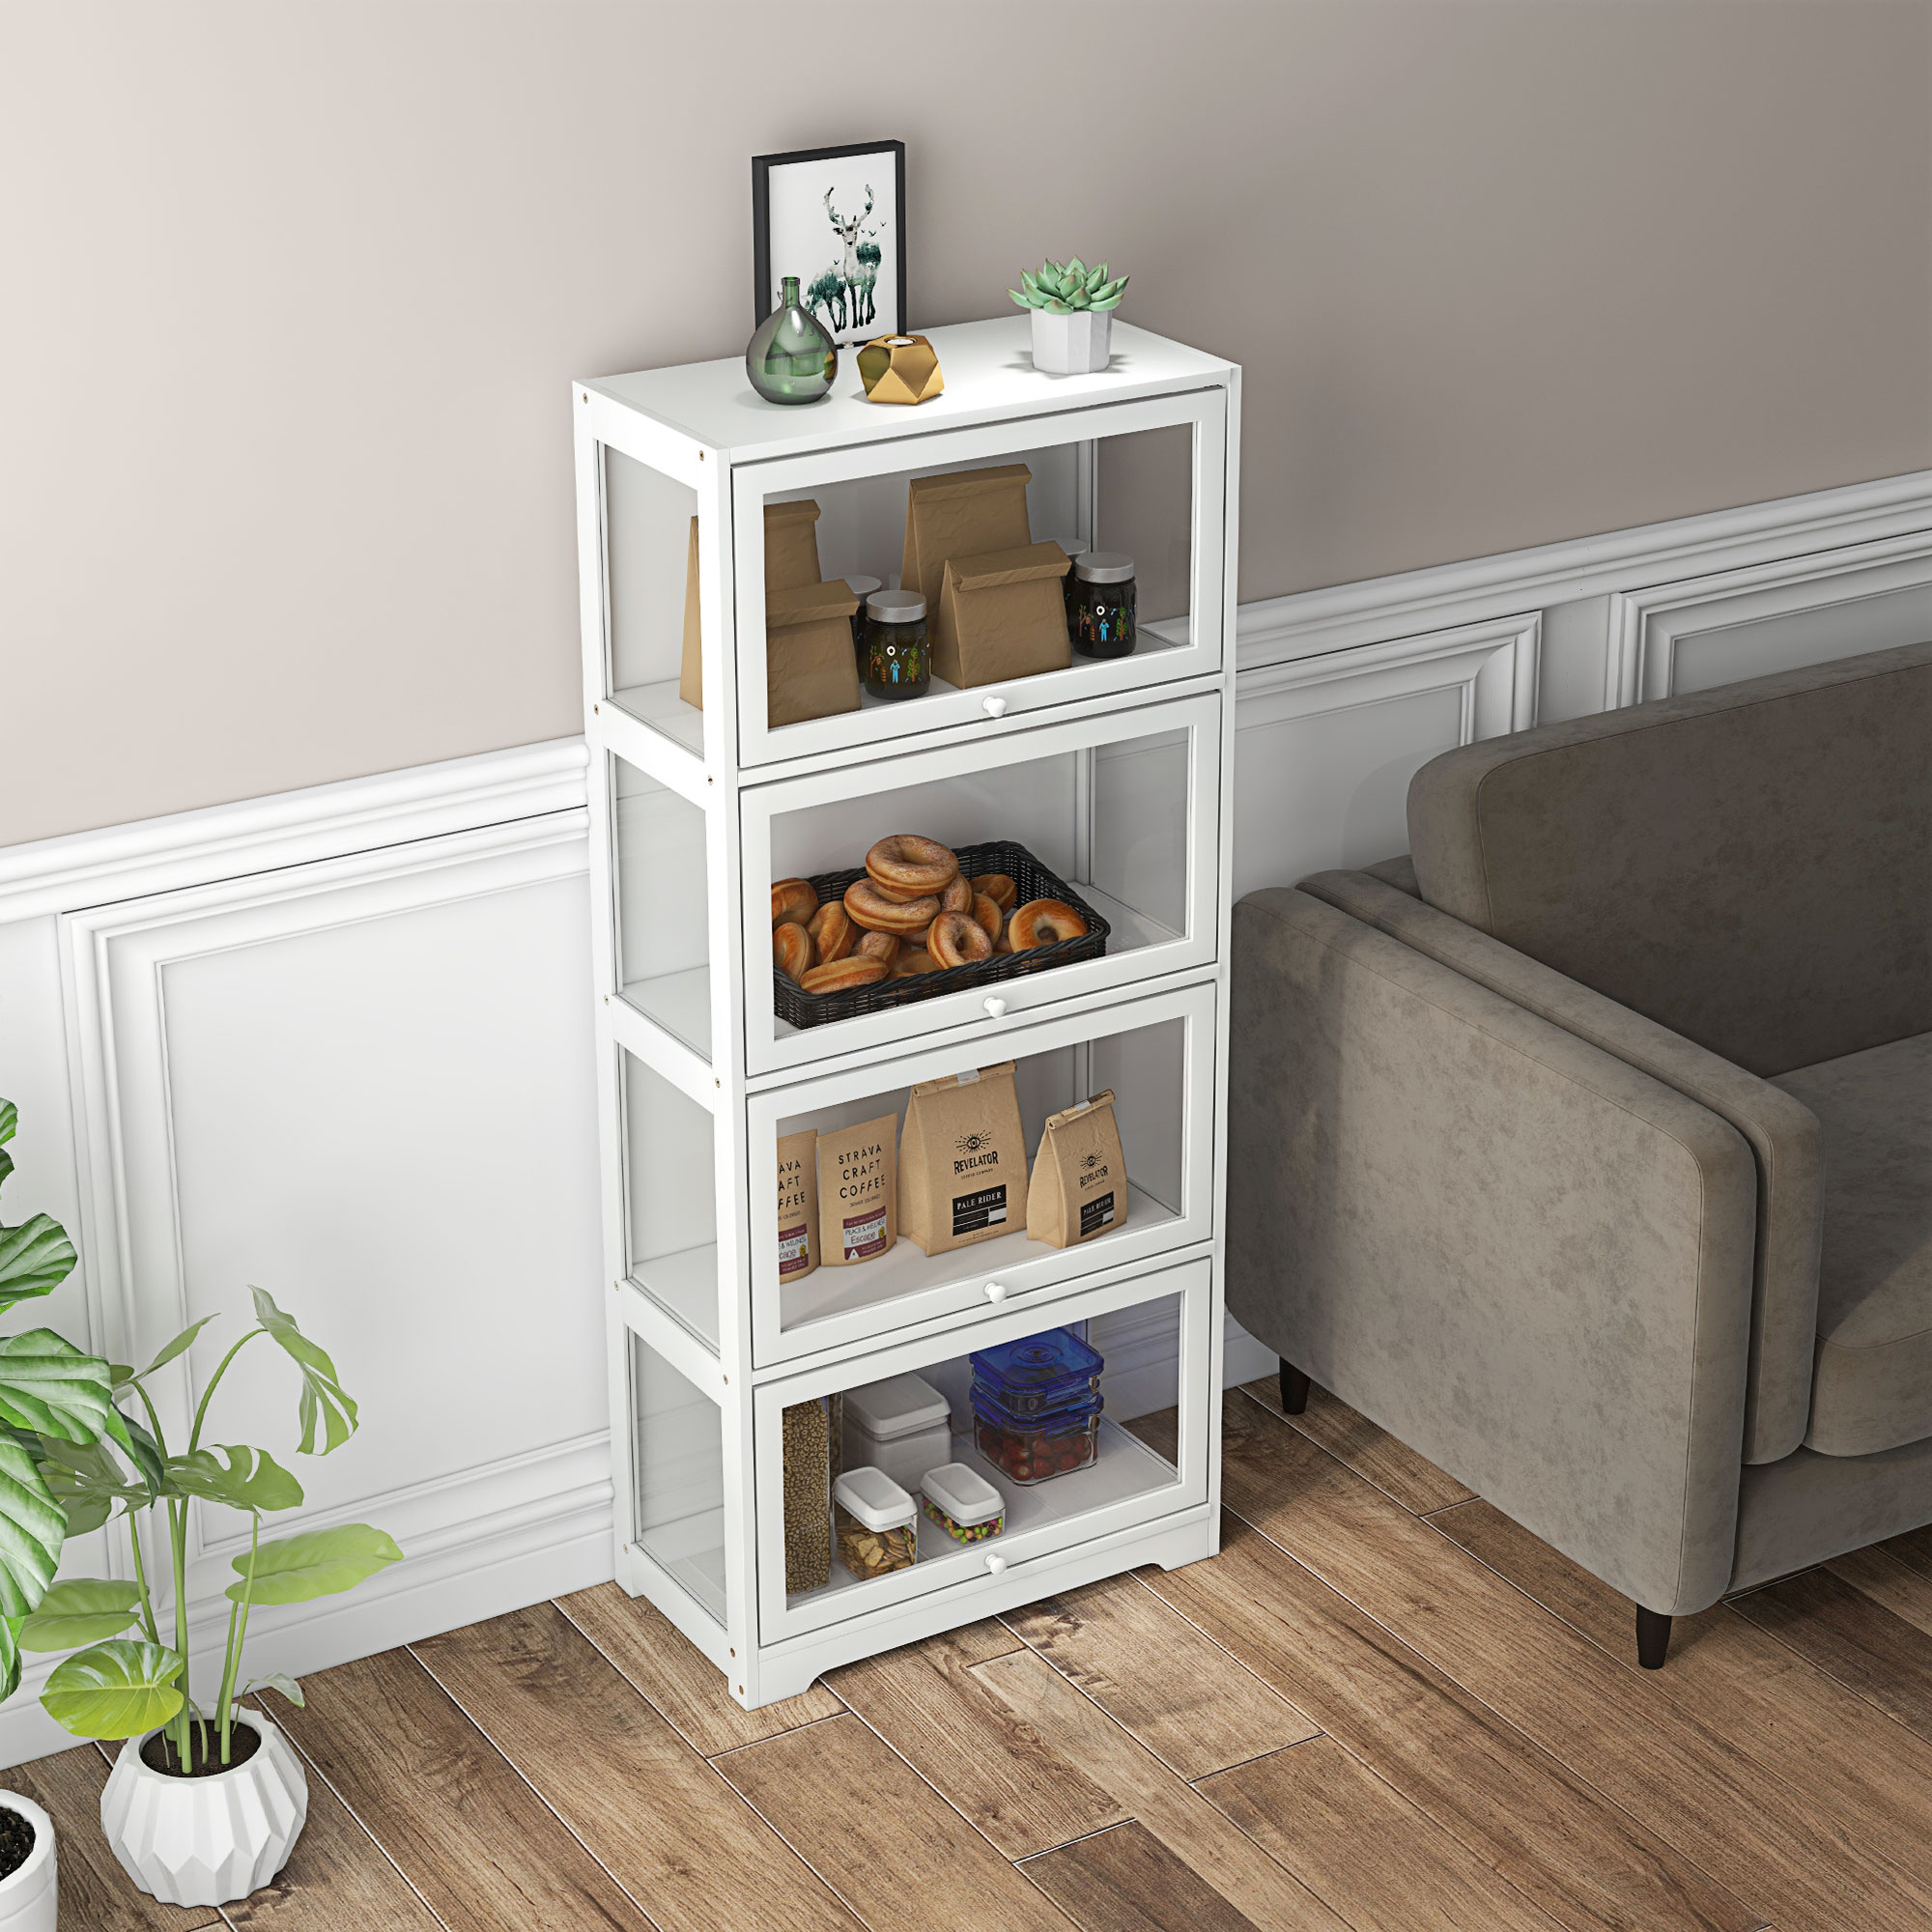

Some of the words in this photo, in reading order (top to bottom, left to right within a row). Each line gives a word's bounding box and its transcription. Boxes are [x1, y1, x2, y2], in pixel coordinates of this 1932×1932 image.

[842, 1159, 881, 1180] CRAFT
[953, 1151, 999, 1175] REVELATOR
[778, 1175, 800, 1192] AFT
[839, 1174, 886, 1199] COFFEE
[1079, 1165, 1109, 1188] REVELATOR
[778, 1191, 806, 1210] FFEE
[956, 1198, 976, 1210] PALE
[978, 1191, 1002, 1205] RIDER
